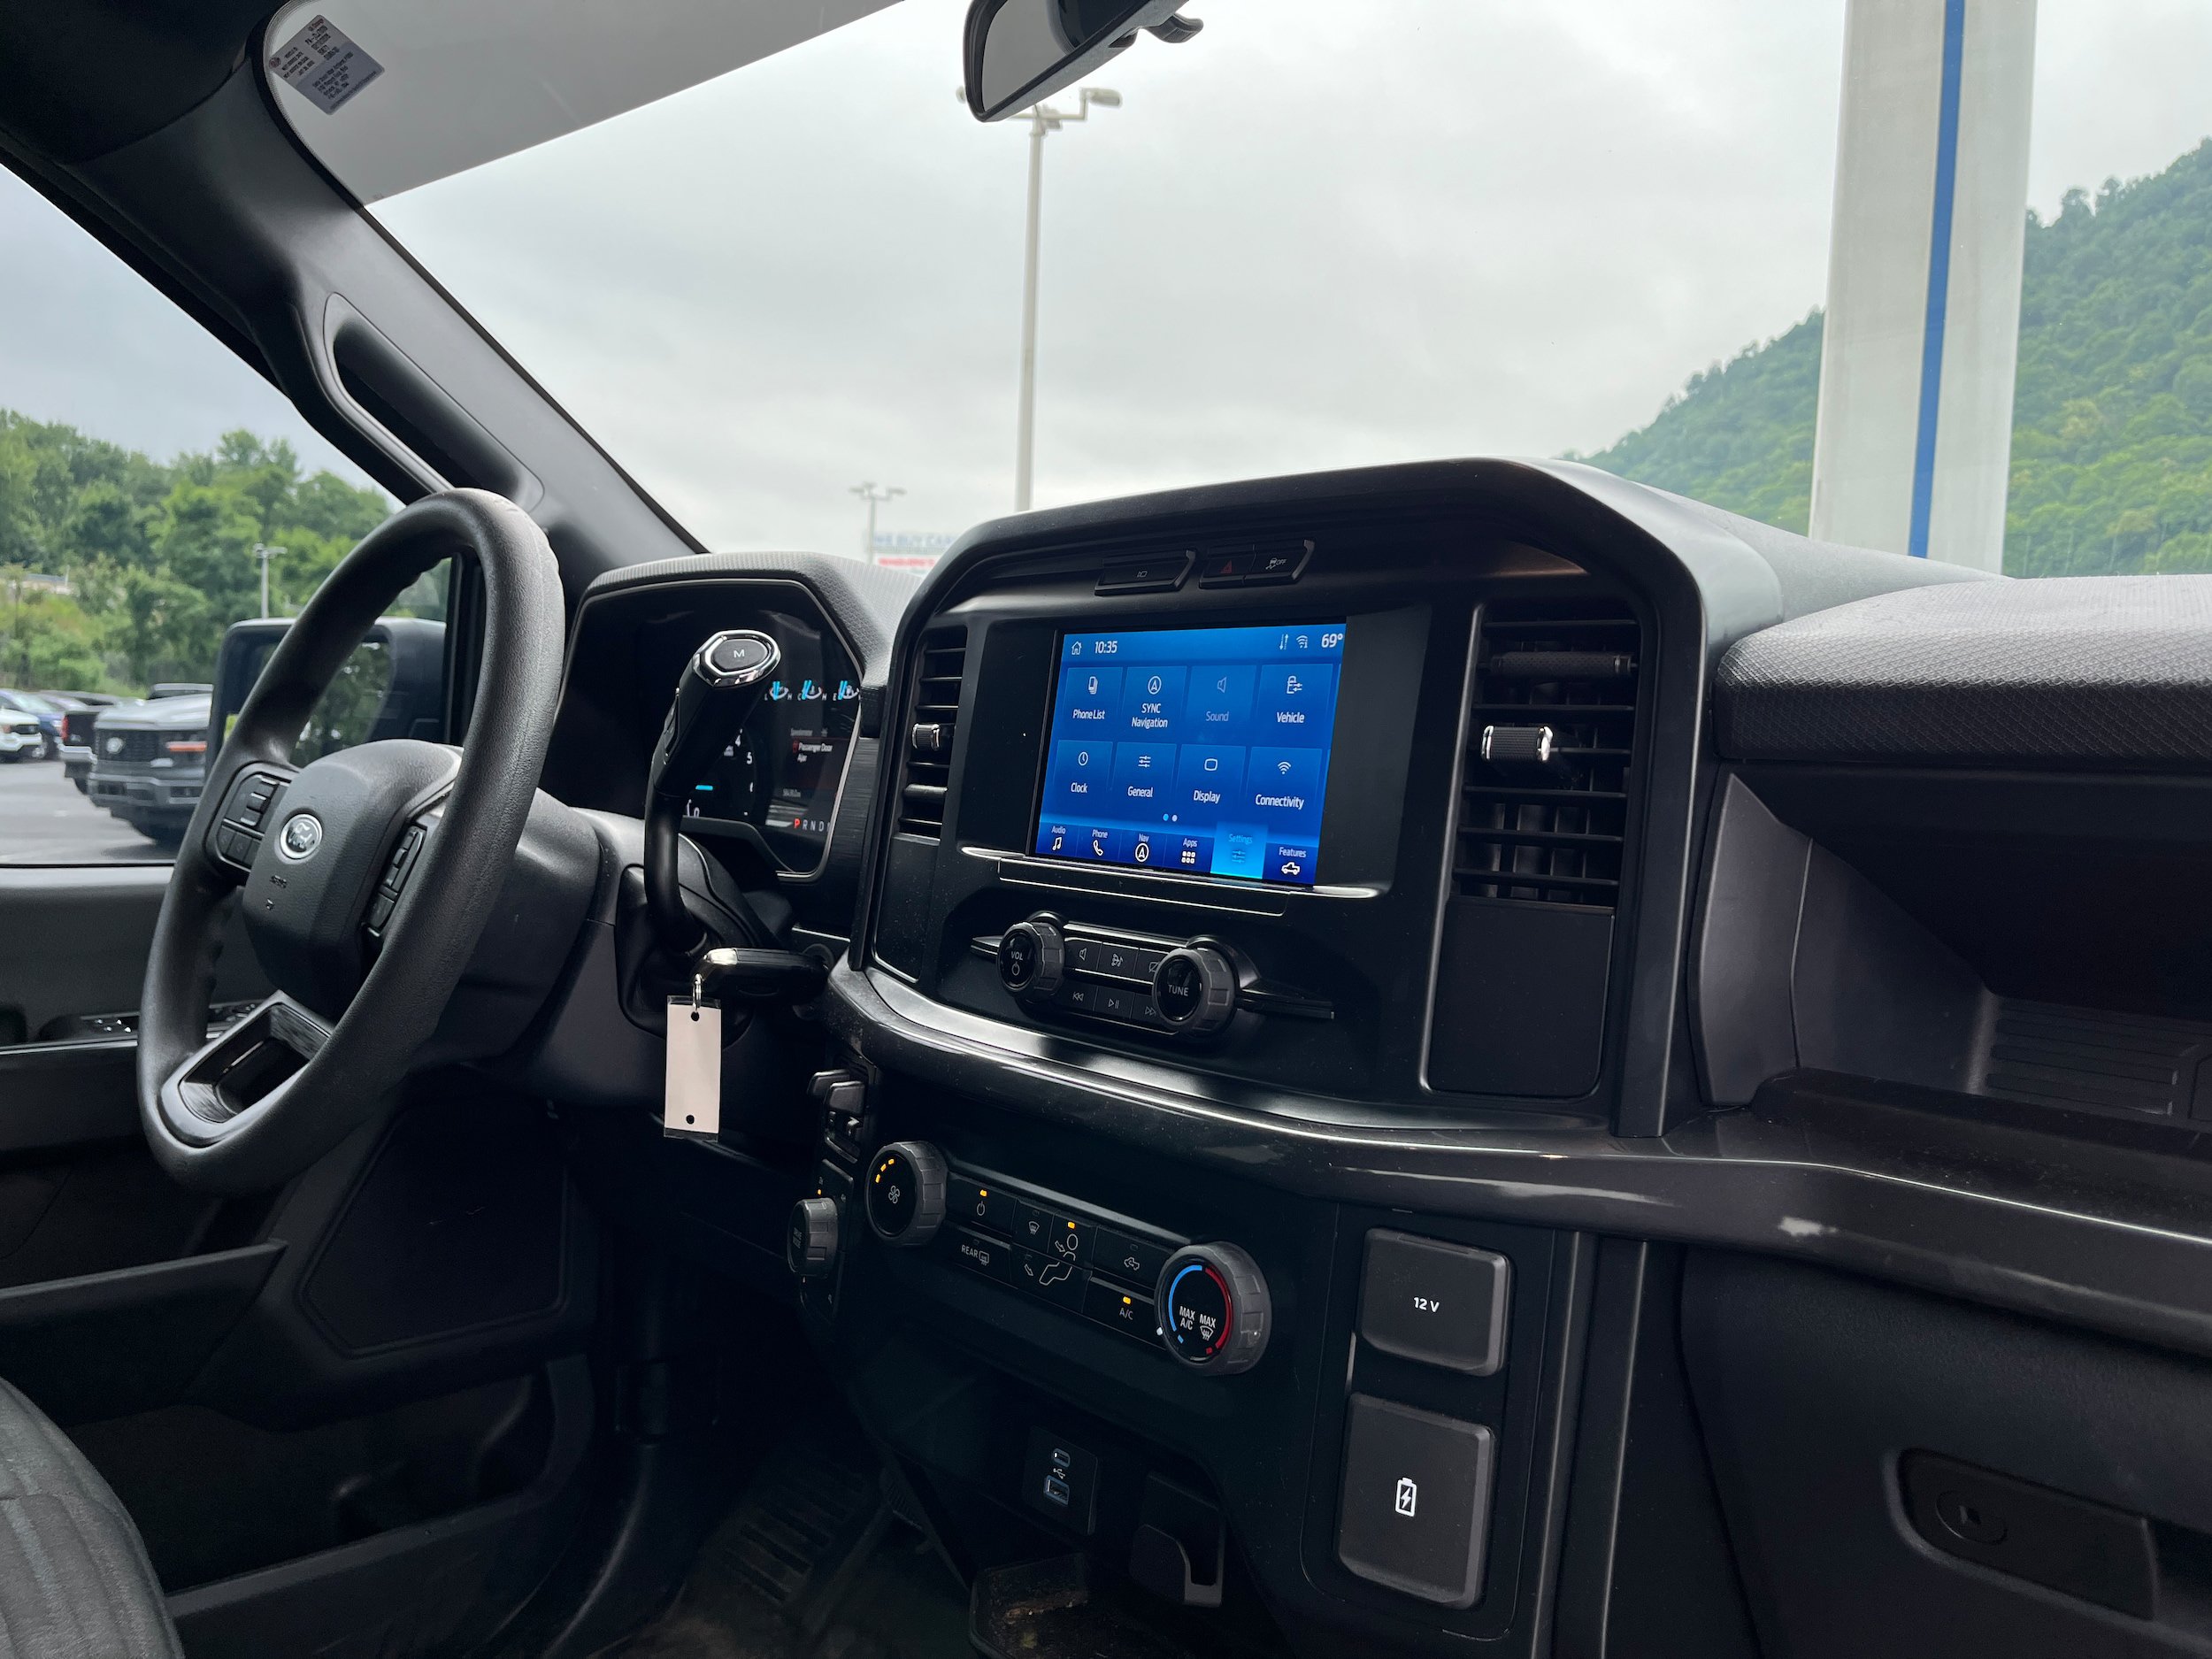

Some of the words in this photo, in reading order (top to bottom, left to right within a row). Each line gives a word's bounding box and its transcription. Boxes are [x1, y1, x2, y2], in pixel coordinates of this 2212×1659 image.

[1094, 640, 1118, 654] 10:35
[1072, 709, 1093, 719] Phone
[1093, 710, 1105, 720] List
[1141, 703, 1161, 714] SYNC
[1205, 710, 1229, 722] Sound
[1277, 711, 1304, 724] Vehicle
[1131, 717, 1168, 729] Navigation
[798, 741, 821, 753] Passenger
[821, 743, 833, 752] Door
[746, 750, 753, 764] 5
[1071, 782, 1087, 794] Clock
[1127, 786, 1153, 798] General
[1194, 790, 1221, 804] Display
[1256, 795, 1304, 810] Connectivity
[794, 818, 801, 829] P
[803, 818, 808, 831] R
[810, 819, 816, 832] N
[818, 820, 825, 832] D
[1051, 826, 1066, 834] Audio
[1092, 828, 1108, 839] Phone
[1138, 833, 1149, 842] Nav
[1228, 833, 1253, 845] Settings
[1183, 838, 1197, 849] Apps
[1279, 847, 1307, 858] Features
[1010, 949, 1024, 961] VOL
[1168, 983, 1189, 997] TUNE
[961, 1244, 979, 1258] REAR
[1414, 1297, 1427, 1310] 12
[1430, 1301, 1440, 1312] V
[1118, 1306, 1133, 1320] A/C
[1179, 1304, 1195, 1321] MAX
[1179, 1317, 1194, 1331] A/C
[1199, 1313, 1217, 1329] MAX
